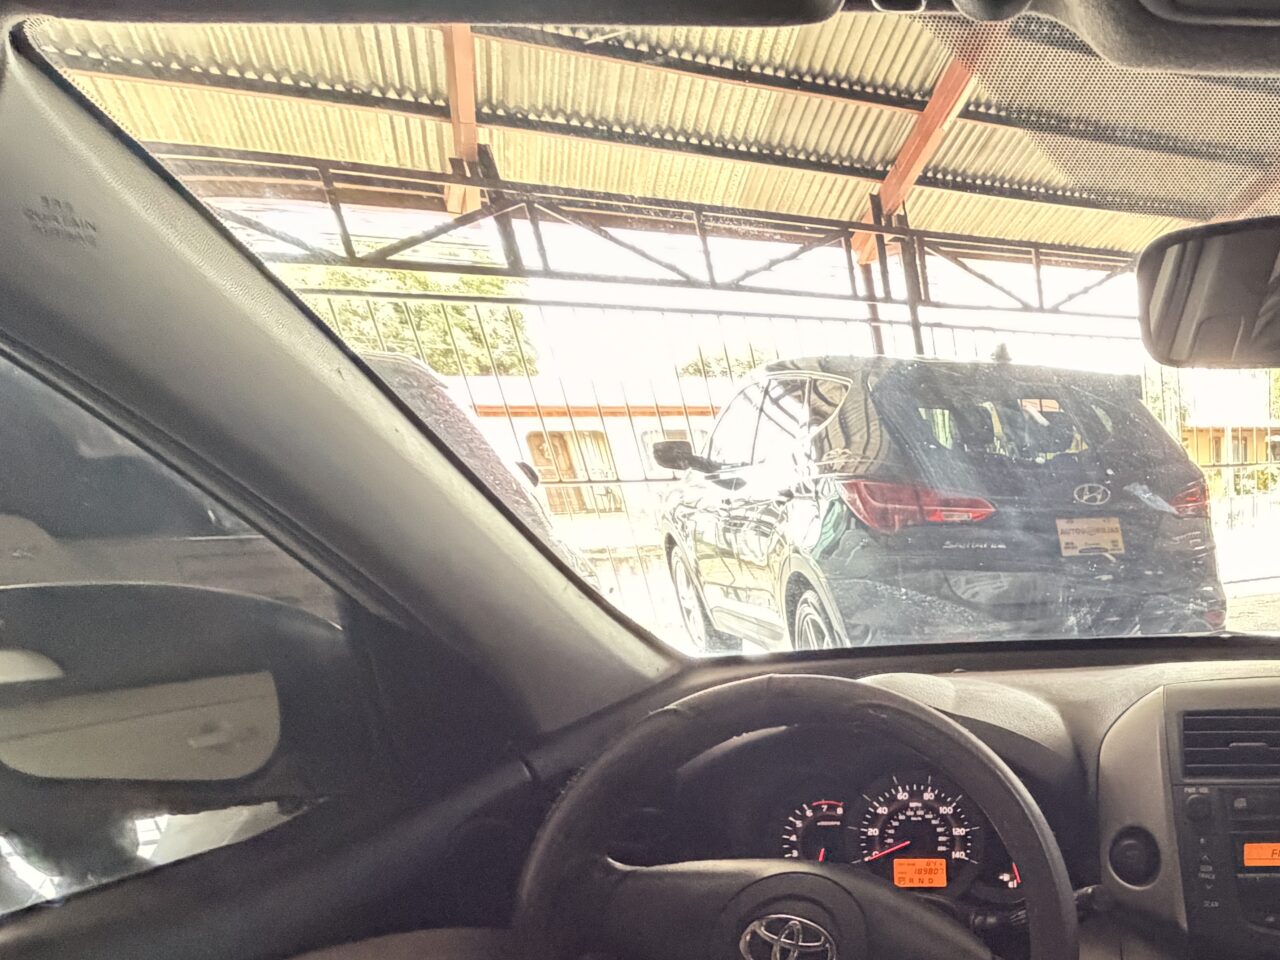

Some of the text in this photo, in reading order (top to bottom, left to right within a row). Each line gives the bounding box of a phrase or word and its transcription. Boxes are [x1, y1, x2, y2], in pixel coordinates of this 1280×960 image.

[897, 792, 909, 800] 60
[923, 792, 935, 800] 80
[876, 806, 889, 815] 40
[939, 806, 953, 815] 100
[867, 828, 879, 836] 20
[952, 828, 966, 836] 120
[951, 851, 966, 859] 140
